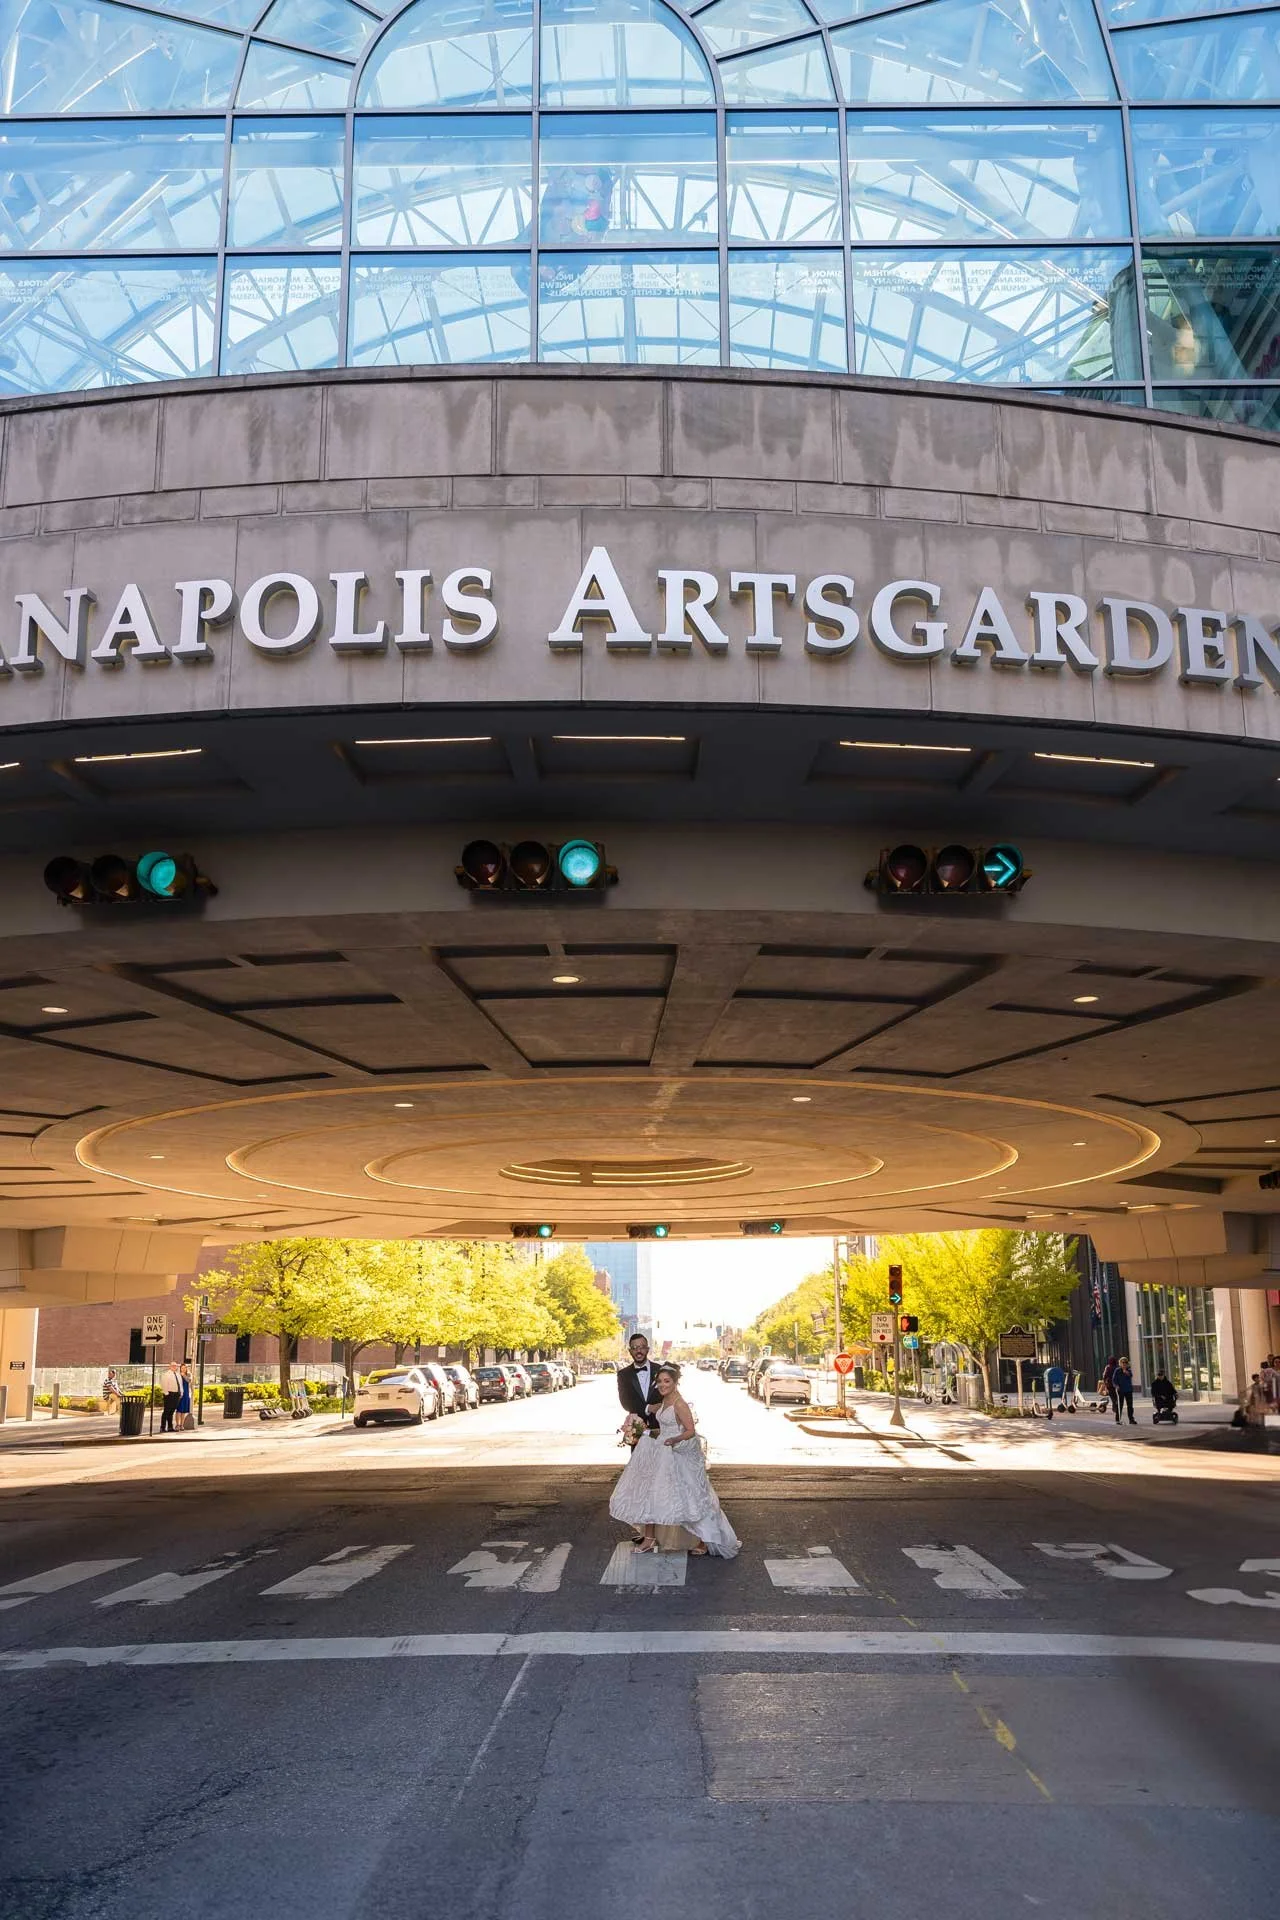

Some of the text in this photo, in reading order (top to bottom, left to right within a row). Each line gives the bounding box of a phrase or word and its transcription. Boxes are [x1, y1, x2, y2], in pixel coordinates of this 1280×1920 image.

[0, 567, 499, 675] NAPOLIS
[146, 1316, 164, 1324] ONE
[146, 1324, 164, 1332] WAY
